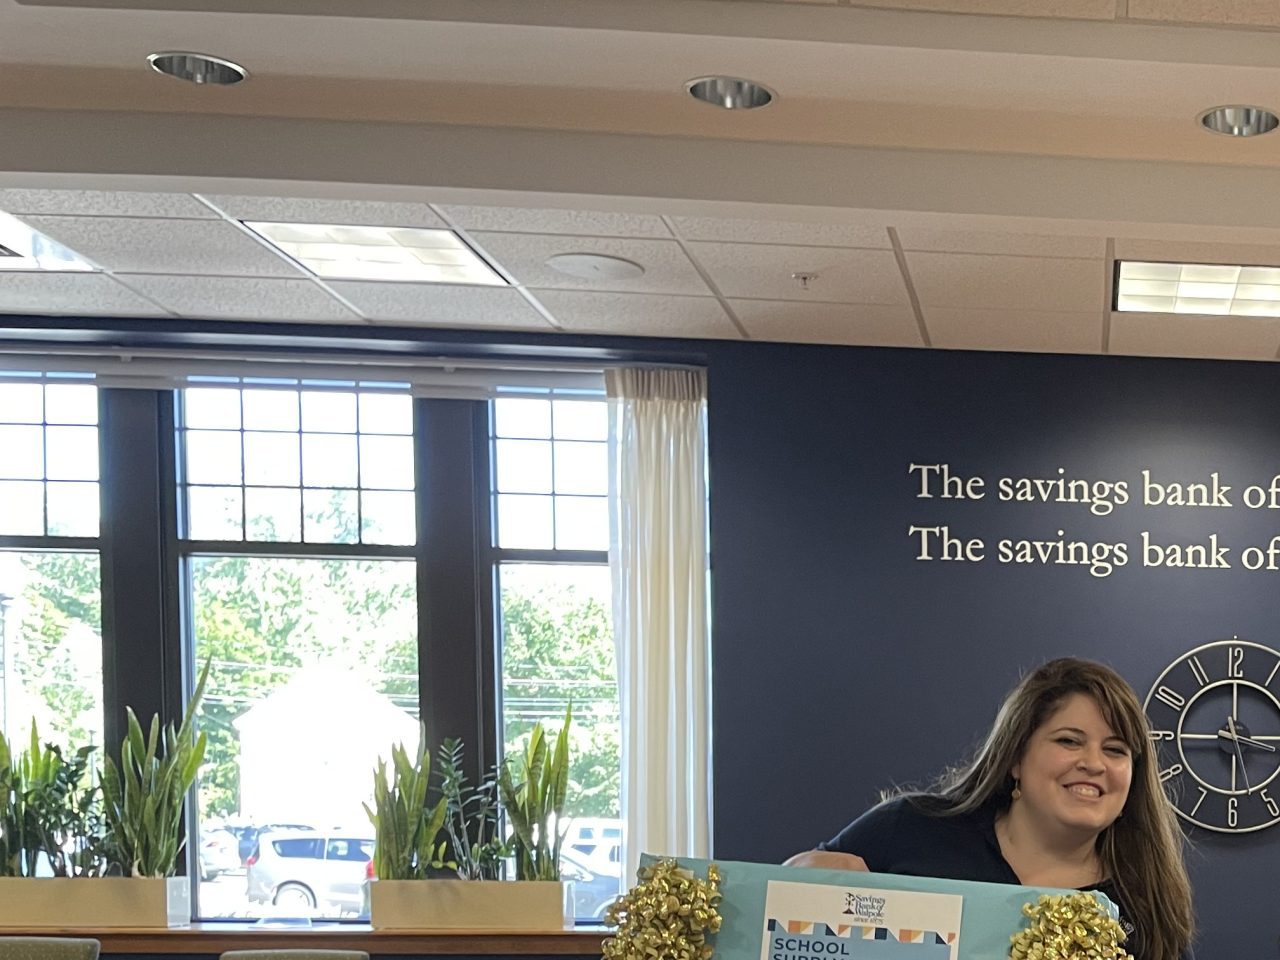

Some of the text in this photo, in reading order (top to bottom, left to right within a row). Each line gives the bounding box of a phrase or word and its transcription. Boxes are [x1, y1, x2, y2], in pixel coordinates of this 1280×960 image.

[909, 464, 984, 499] The
[999, 468, 1128, 515] savings
[1142, 471, 1232, 508] bank
[909, 526, 984, 561] The
[999, 529, 1128, 576] savings
[1142, 532, 1231, 569] bank
[1228, 646, 1244, 678] 12
[1154, 685, 1186, 711] 10
[1190, 786, 1208, 817] 7
[1228, 797, 1238, 827] 6
[1260, 788, 1280, 817] 5
[855, 894, 886, 905] Savings
[774, 938, 850, 955] SCHOOL
